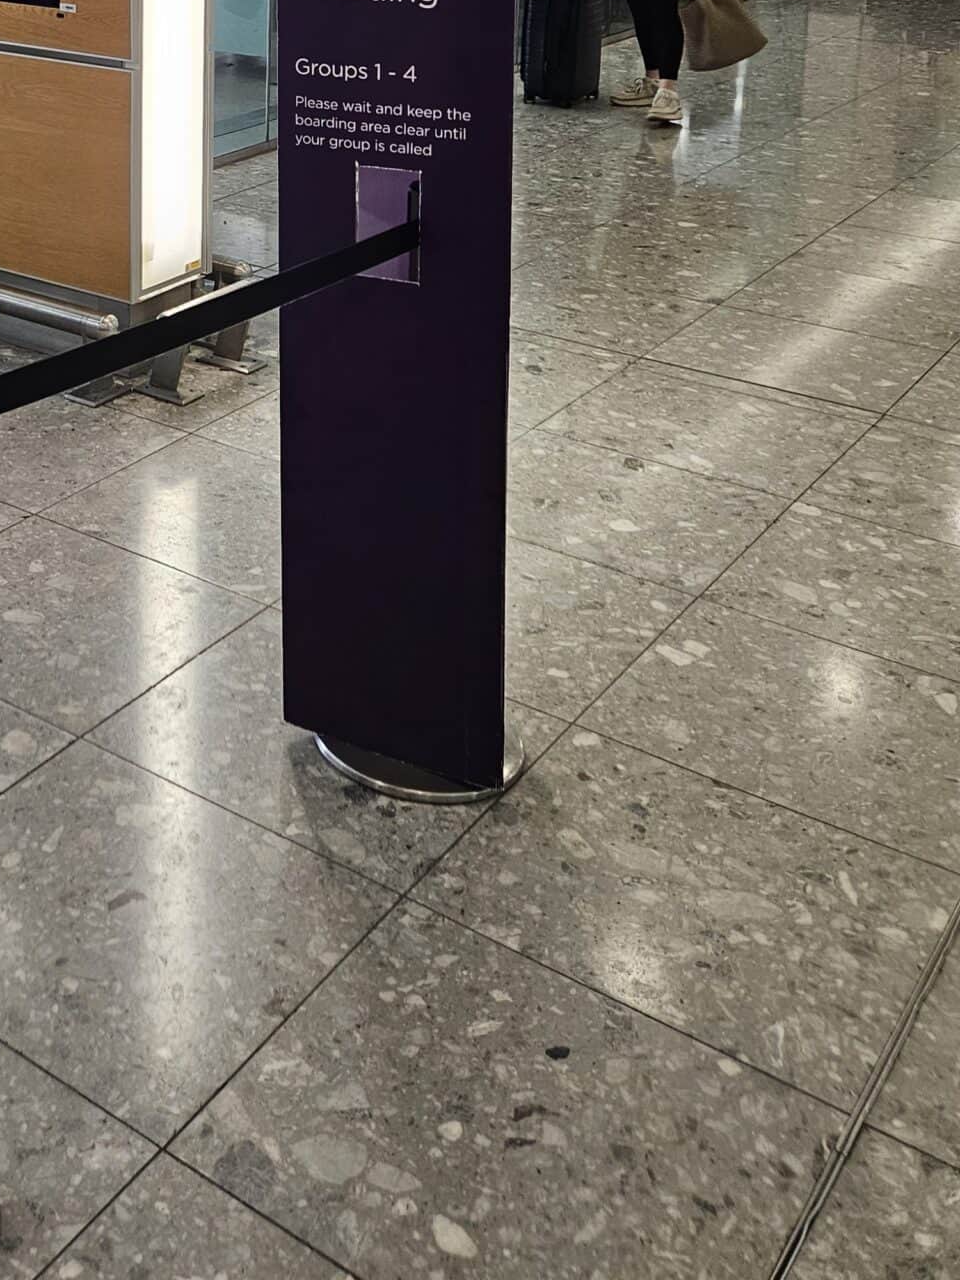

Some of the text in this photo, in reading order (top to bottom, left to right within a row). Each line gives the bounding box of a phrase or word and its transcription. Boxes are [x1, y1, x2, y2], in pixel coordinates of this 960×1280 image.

[295, 58, 368, 82] Groups
[374, 63, 381, 81] 1
[403, 65, 417, 83] 4
[295, 95, 472, 122] Please wait and keep the
[295, 113, 467, 140] boarding area clear until
[295, 134, 433, 157] your group is called
